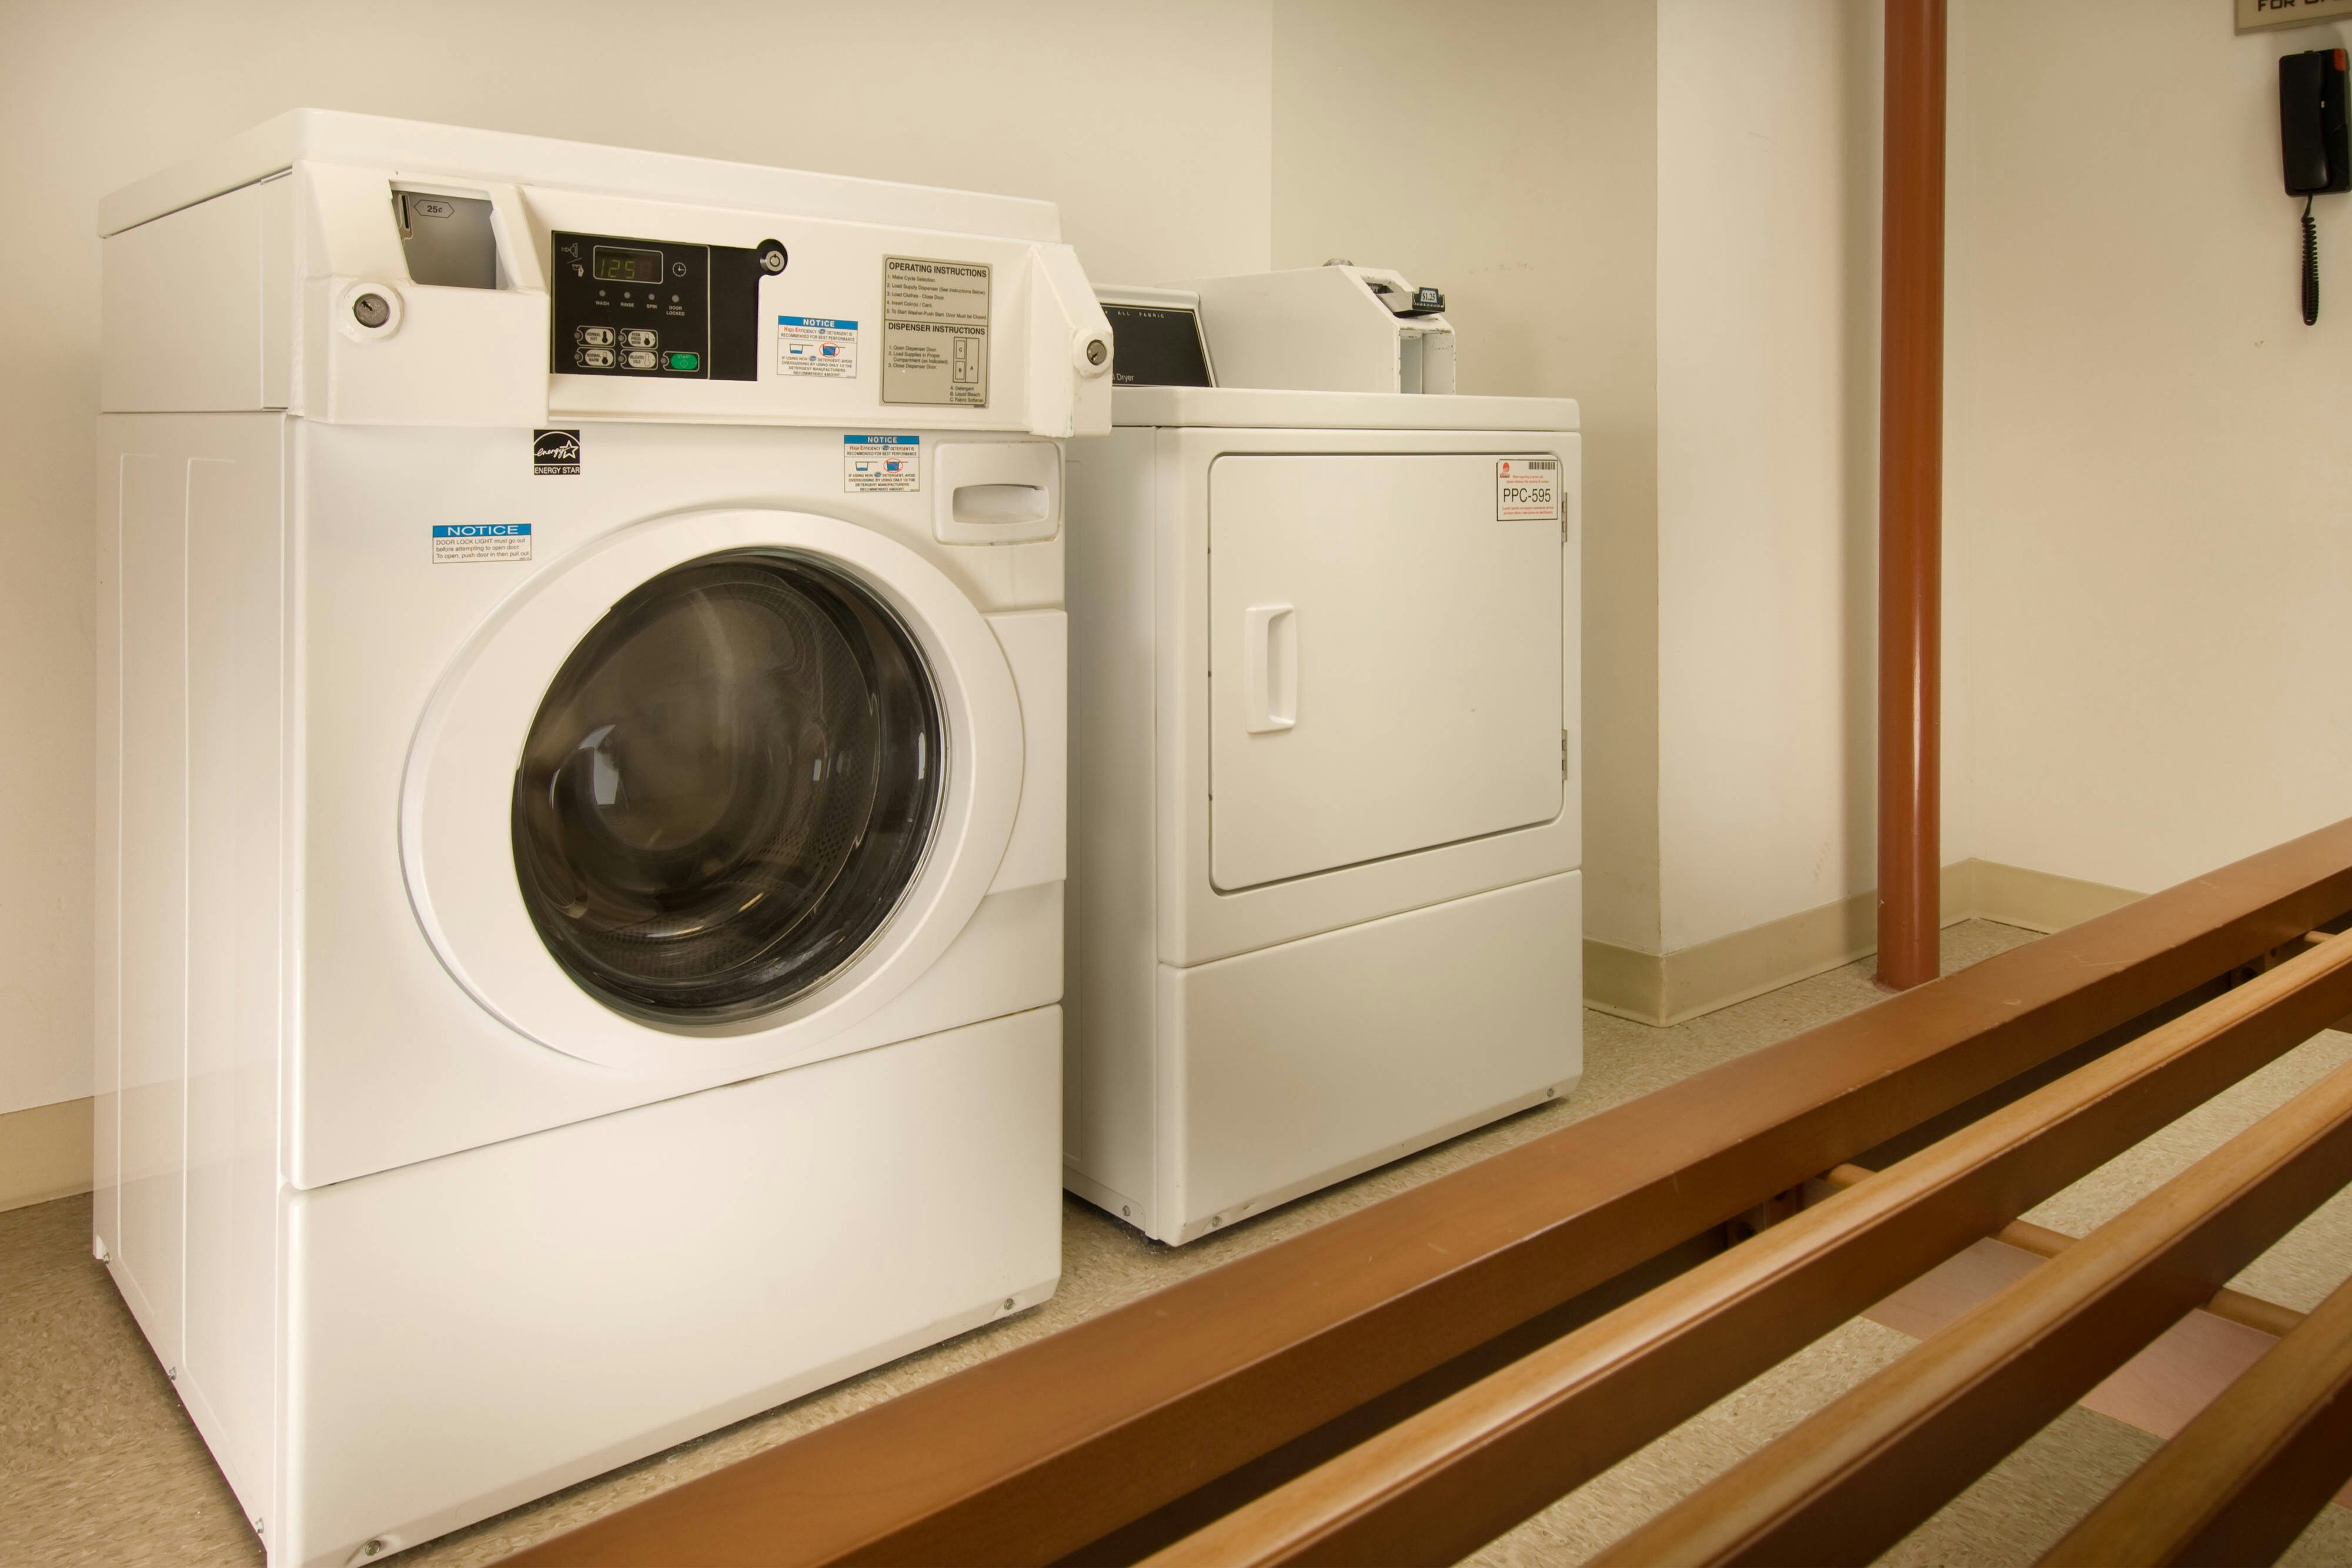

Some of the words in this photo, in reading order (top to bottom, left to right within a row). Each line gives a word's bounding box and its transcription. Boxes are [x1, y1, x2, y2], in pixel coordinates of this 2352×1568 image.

[2258, 0, 2295, 11] FOR
[889, 262, 932, 273] OPERATING
[934, 265, 986, 277] INSTRUCTIONS
[1422, 292, 1435, 300] $1.25
[803, 319, 834, 327] NOTICE
[888, 322, 930, 332] DISPENSER
[933, 325, 985, 335] INSTRUCTIONS
[1117, 373, 1134, 382] Dryer
[1504, 488, 1551, 502] PPC-595
[447, 525, 517, 536] NOTICE
